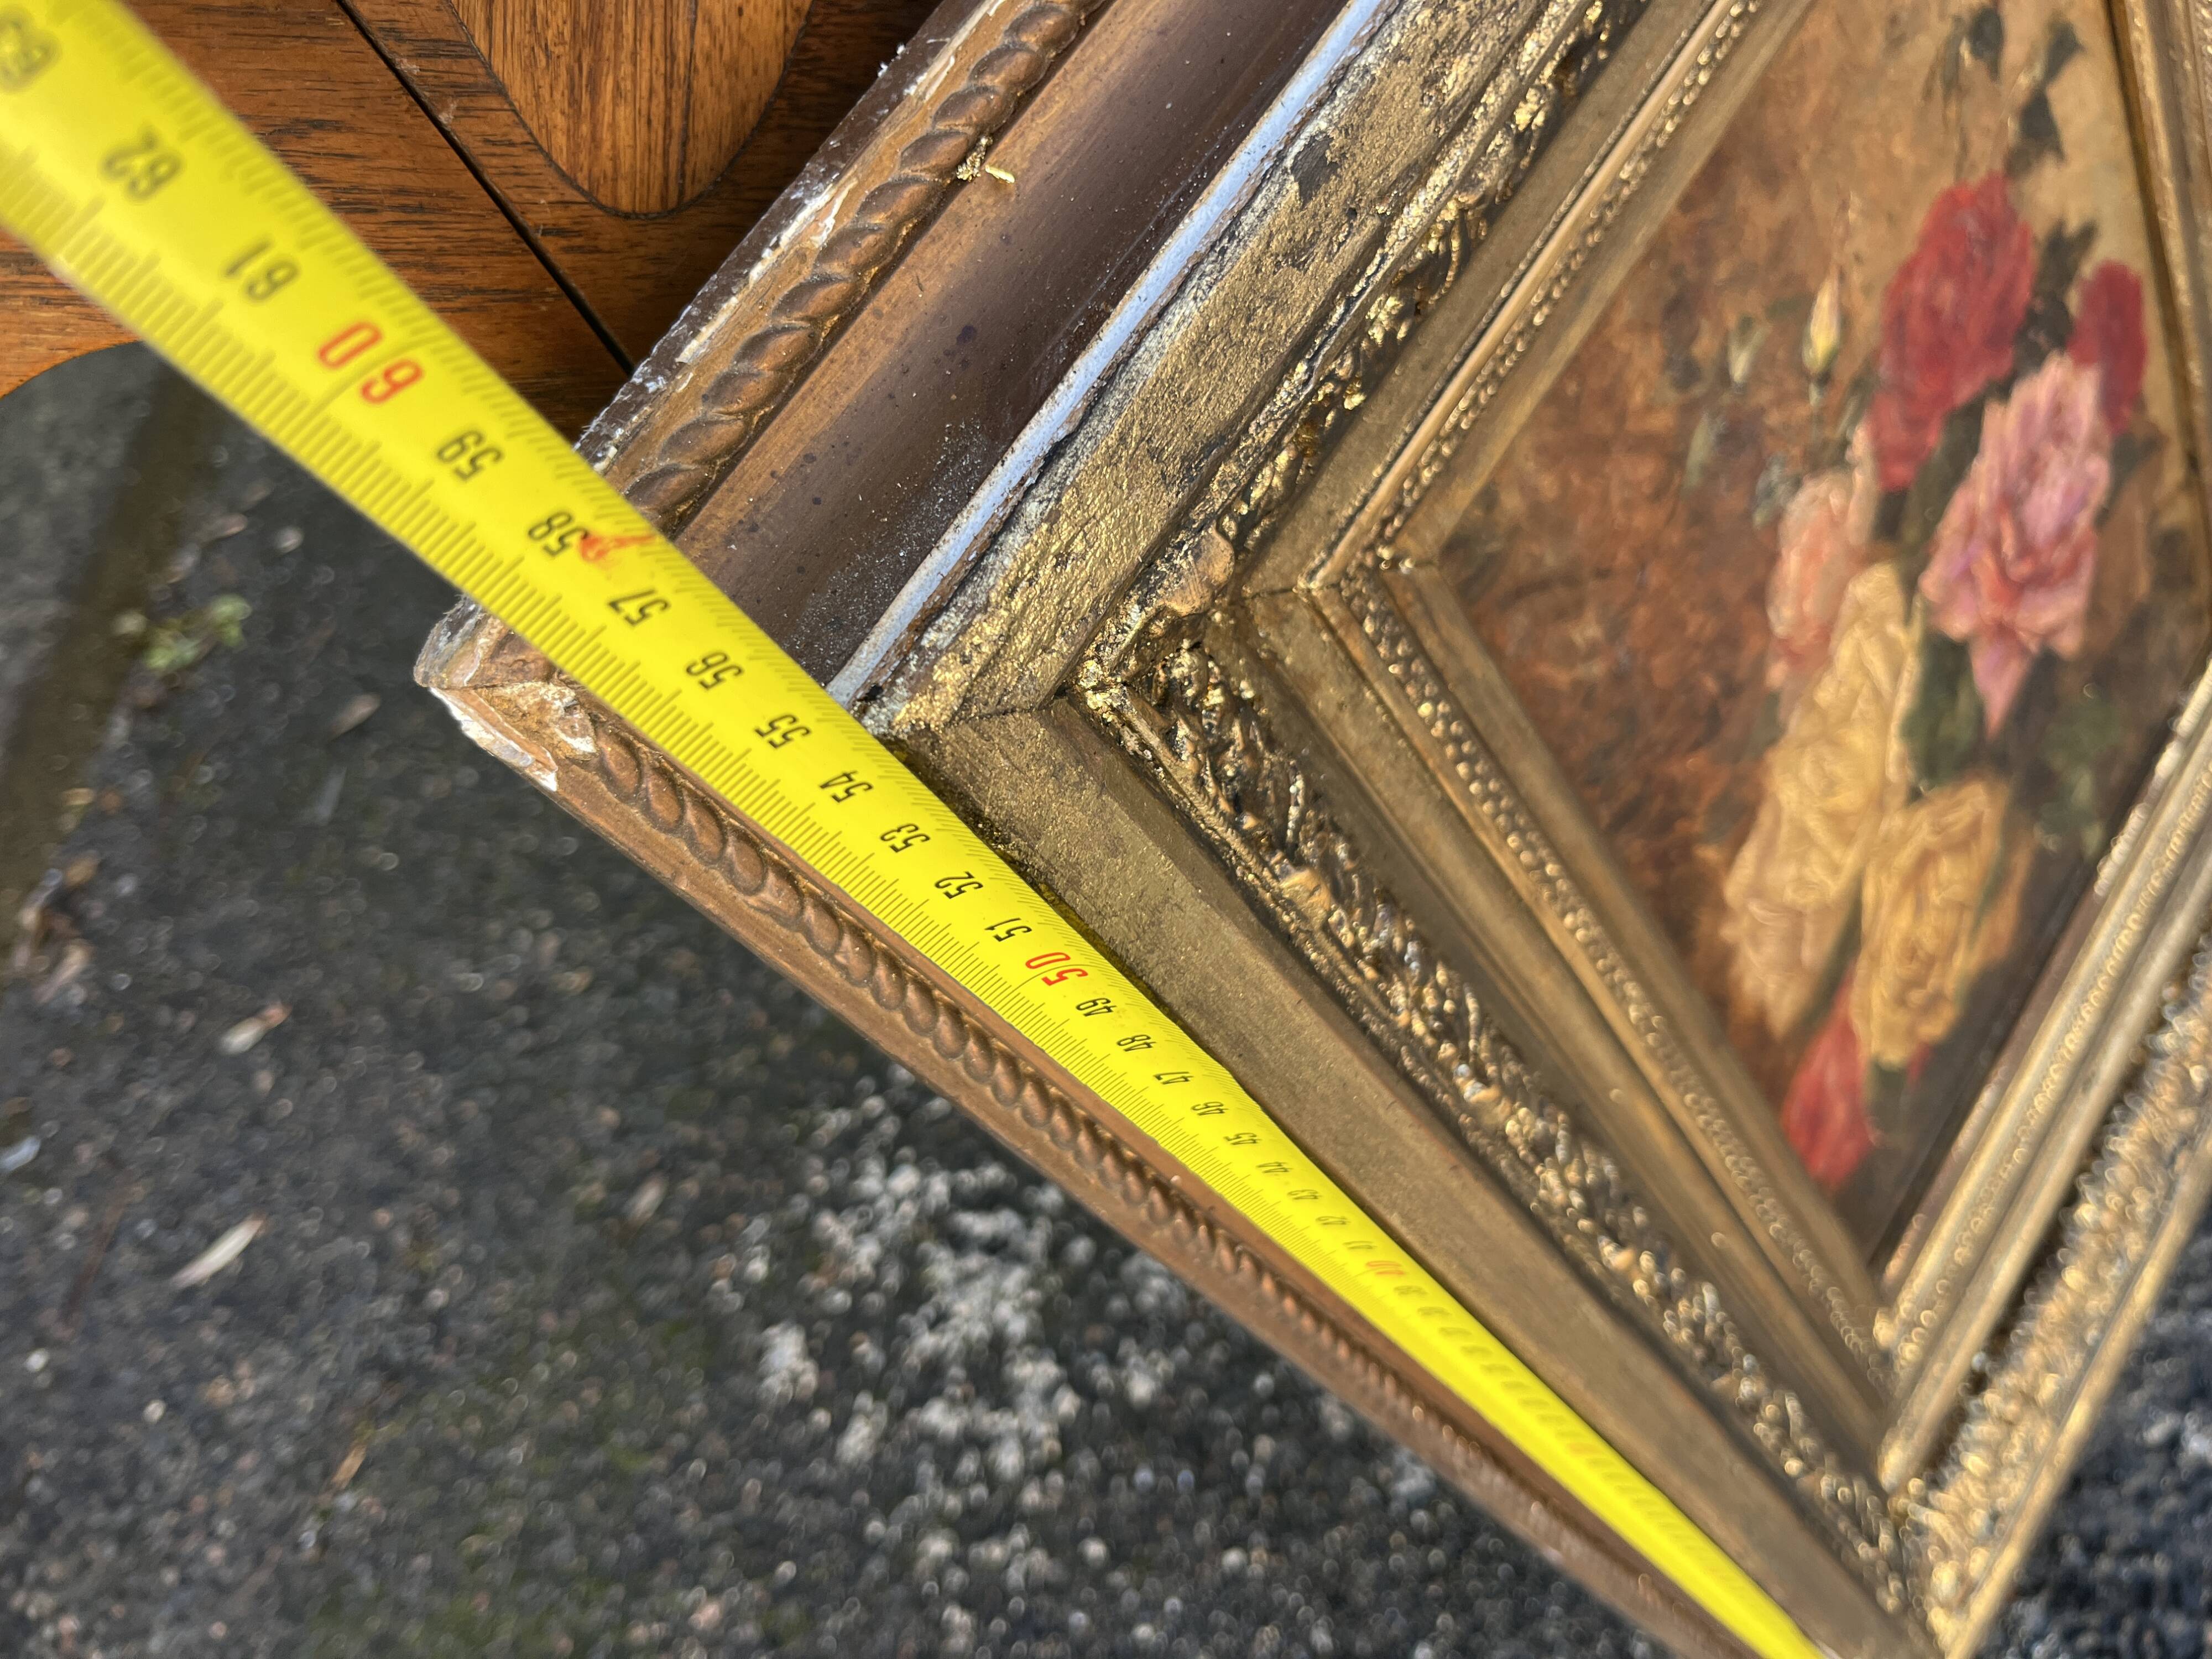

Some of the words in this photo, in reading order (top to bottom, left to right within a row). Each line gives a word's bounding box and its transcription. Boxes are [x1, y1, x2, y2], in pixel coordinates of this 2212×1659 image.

[101, 123, 184, 204] 62
[224, 237, 300, 303] 61
[317, 321, 424, 404] 60
[437, 430, 504, 481] 59
[527, 511, 589, 557] 58
[608, 588, 671, 627] 57
[685, 651, 744, 690] 56
[754, 713, 811, 749] 55
[819, 769, 874, 803] 54
[880, 823, 931, 853] 53
[935, 871, 984, 900] 52
[985, 917, 1032, 942] 51
[1025, 952, 1088, 986] 50
[1076, 998, 1117, 1016] 49
[1117, 1034, 1156, 1051] 48
[1153, 1071, 1193, 1084] 47
[1191, 1102, 1228, 1115] 46
[1223, 1133, 1261, 1145] 45
[1256, 1161, 1293, 1173] 44
[1287, 1190, 1322, 1199] 43
[1316, 1216, 1350, 1225] 42
